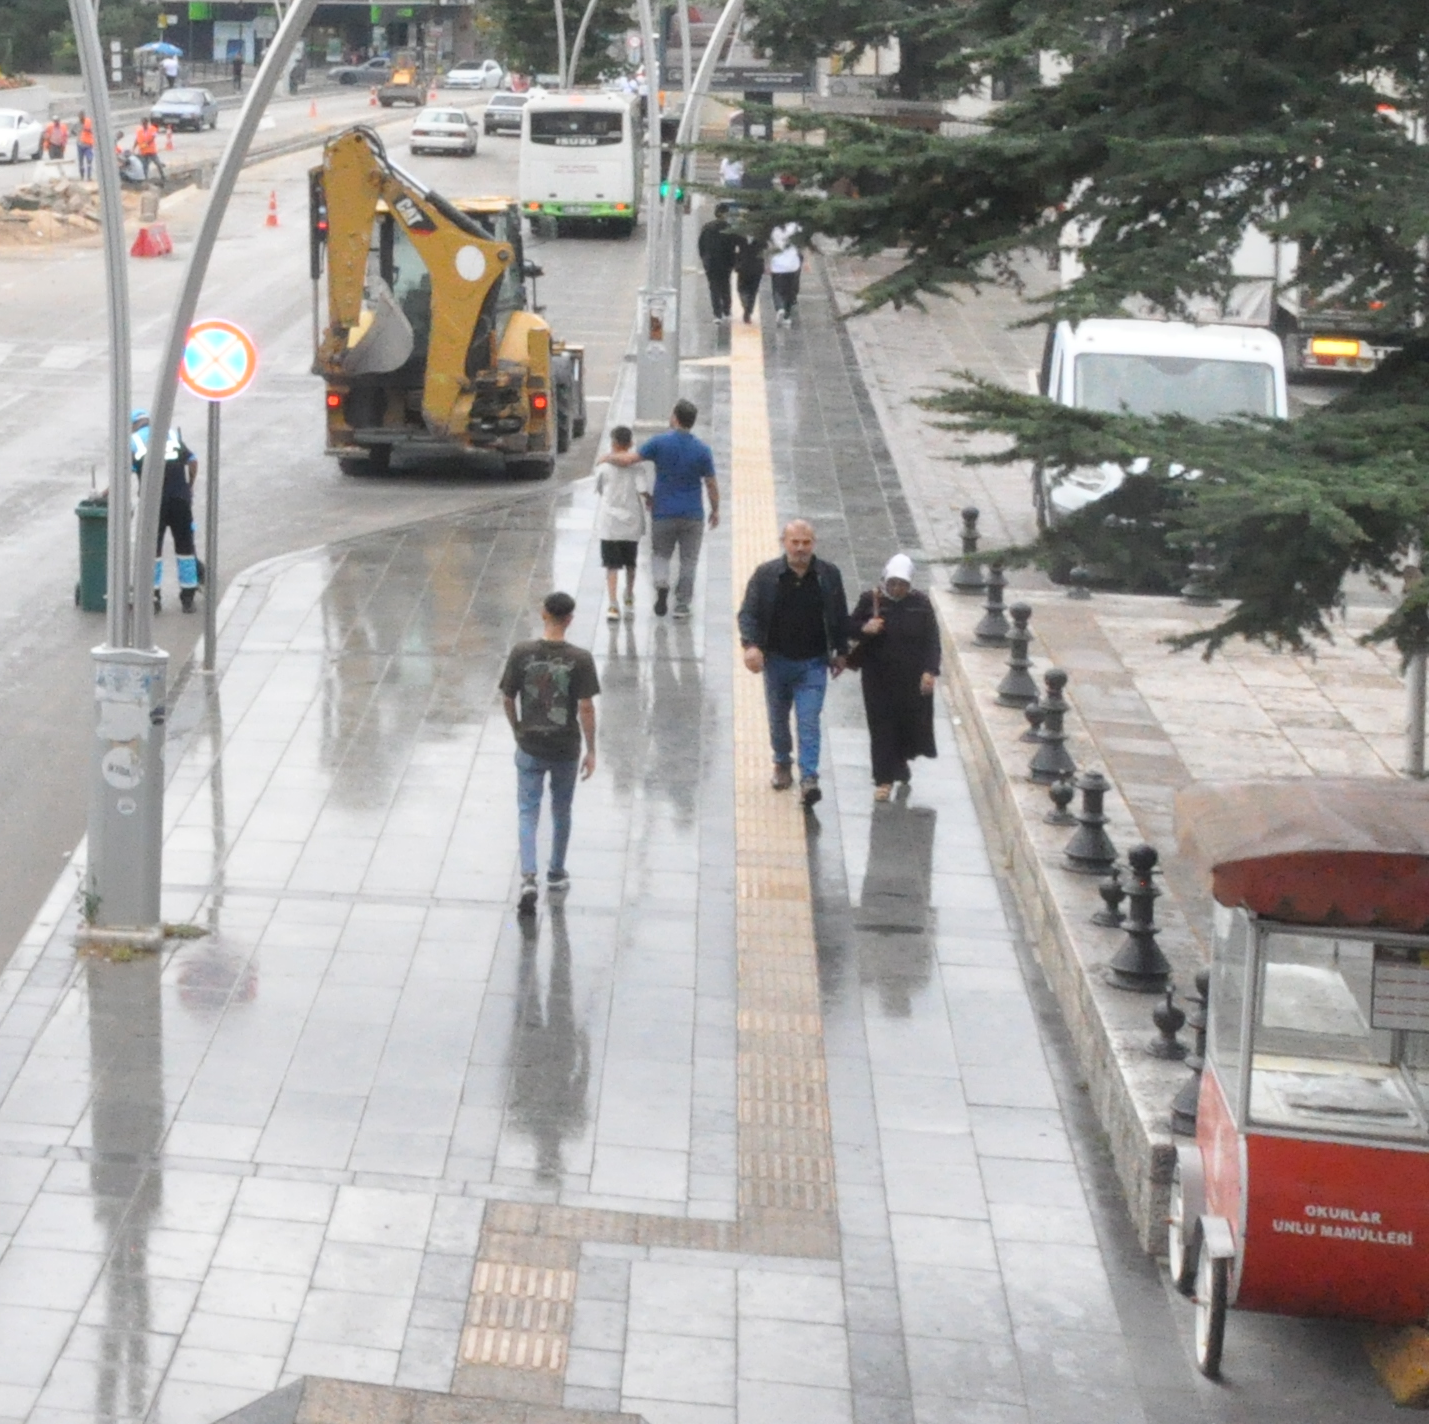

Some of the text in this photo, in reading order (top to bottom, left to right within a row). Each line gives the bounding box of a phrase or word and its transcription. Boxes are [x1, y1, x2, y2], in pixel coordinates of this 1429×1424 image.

[555, 137, 598, 146] ISUZU
[395, 197, 424, 227] CAT
[1304, 1204, 1382, 1225] OKURLAR
[1272, 1219, 1414, 1247] UNLU MAMÜLLERİ
